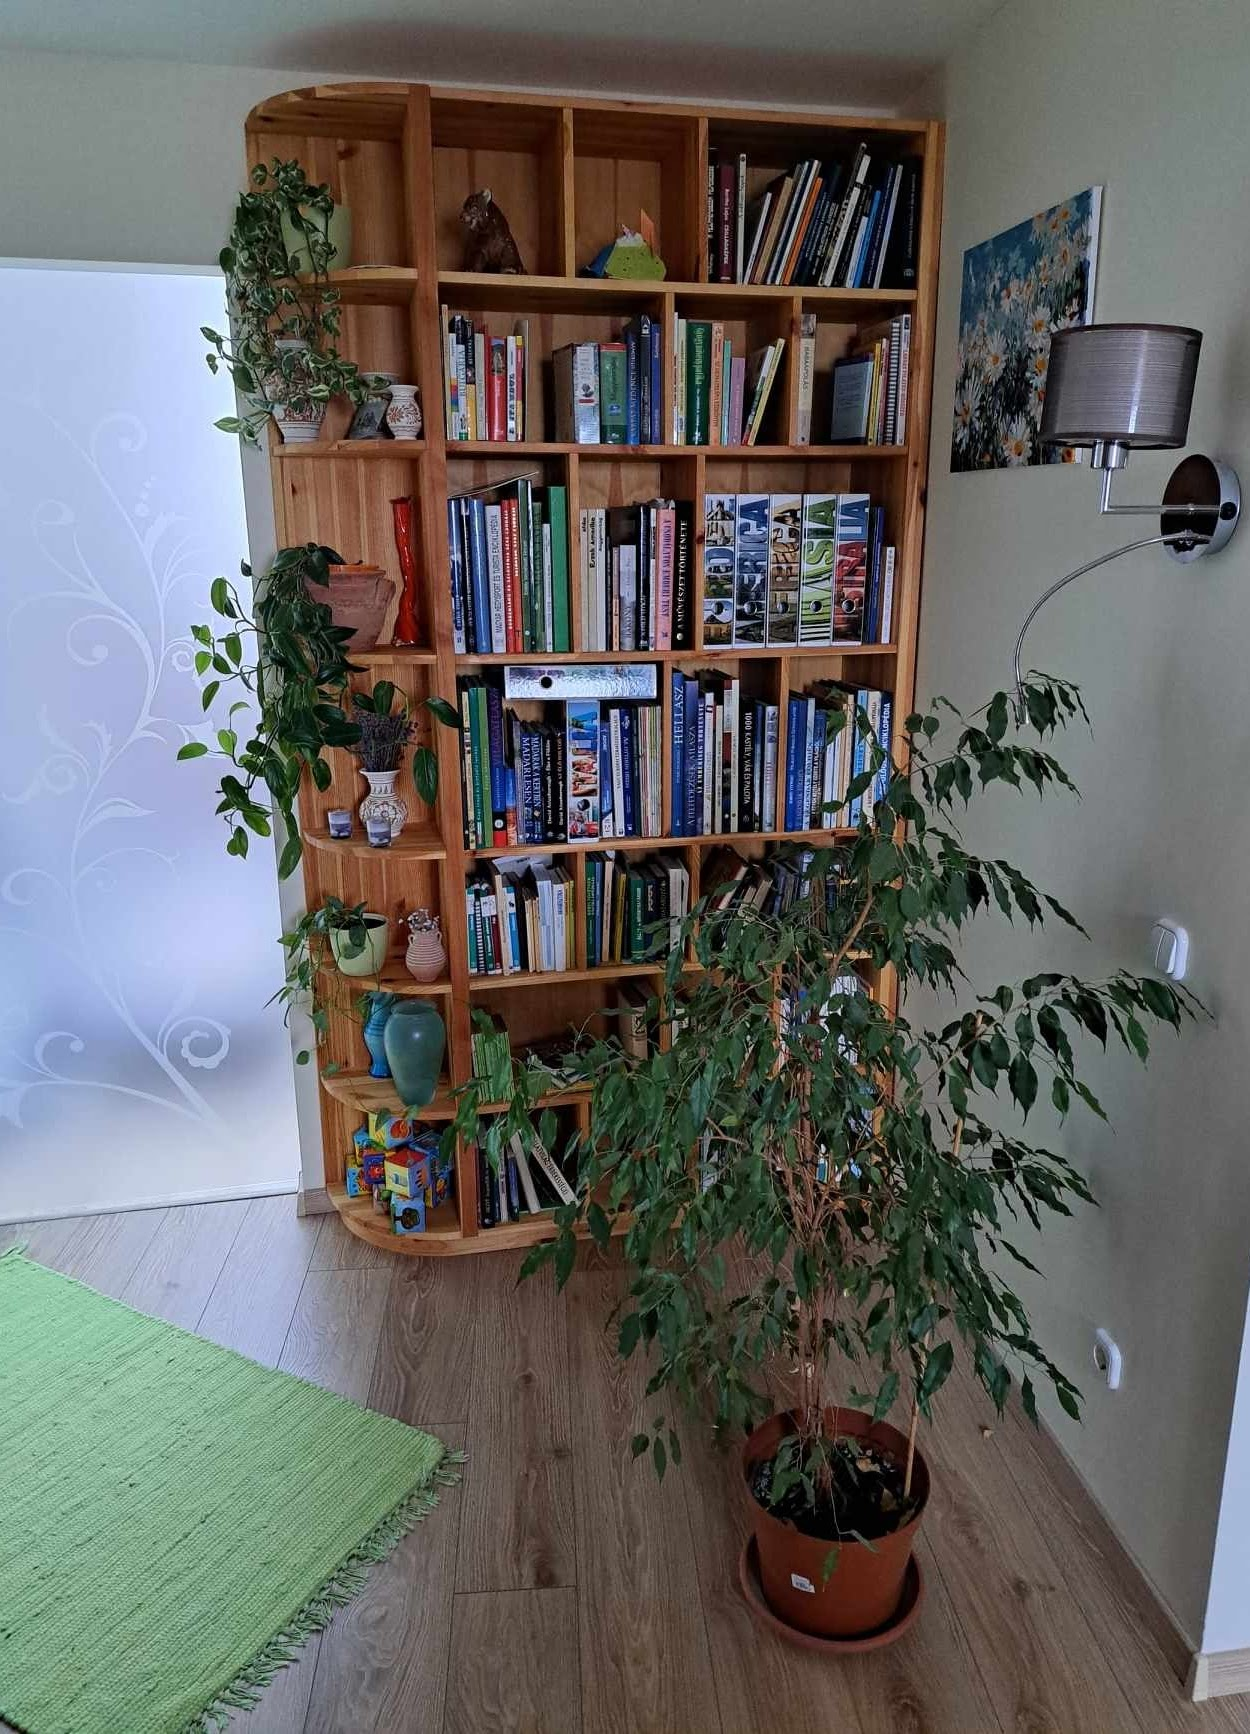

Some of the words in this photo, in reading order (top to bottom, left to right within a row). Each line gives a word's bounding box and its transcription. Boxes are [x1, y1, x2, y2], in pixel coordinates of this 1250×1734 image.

[678, 520, 688, 576] TÖRTÉNETE
[744, 712, 753, 730] 1000
[743, 781, 751, 804] PALOTA
